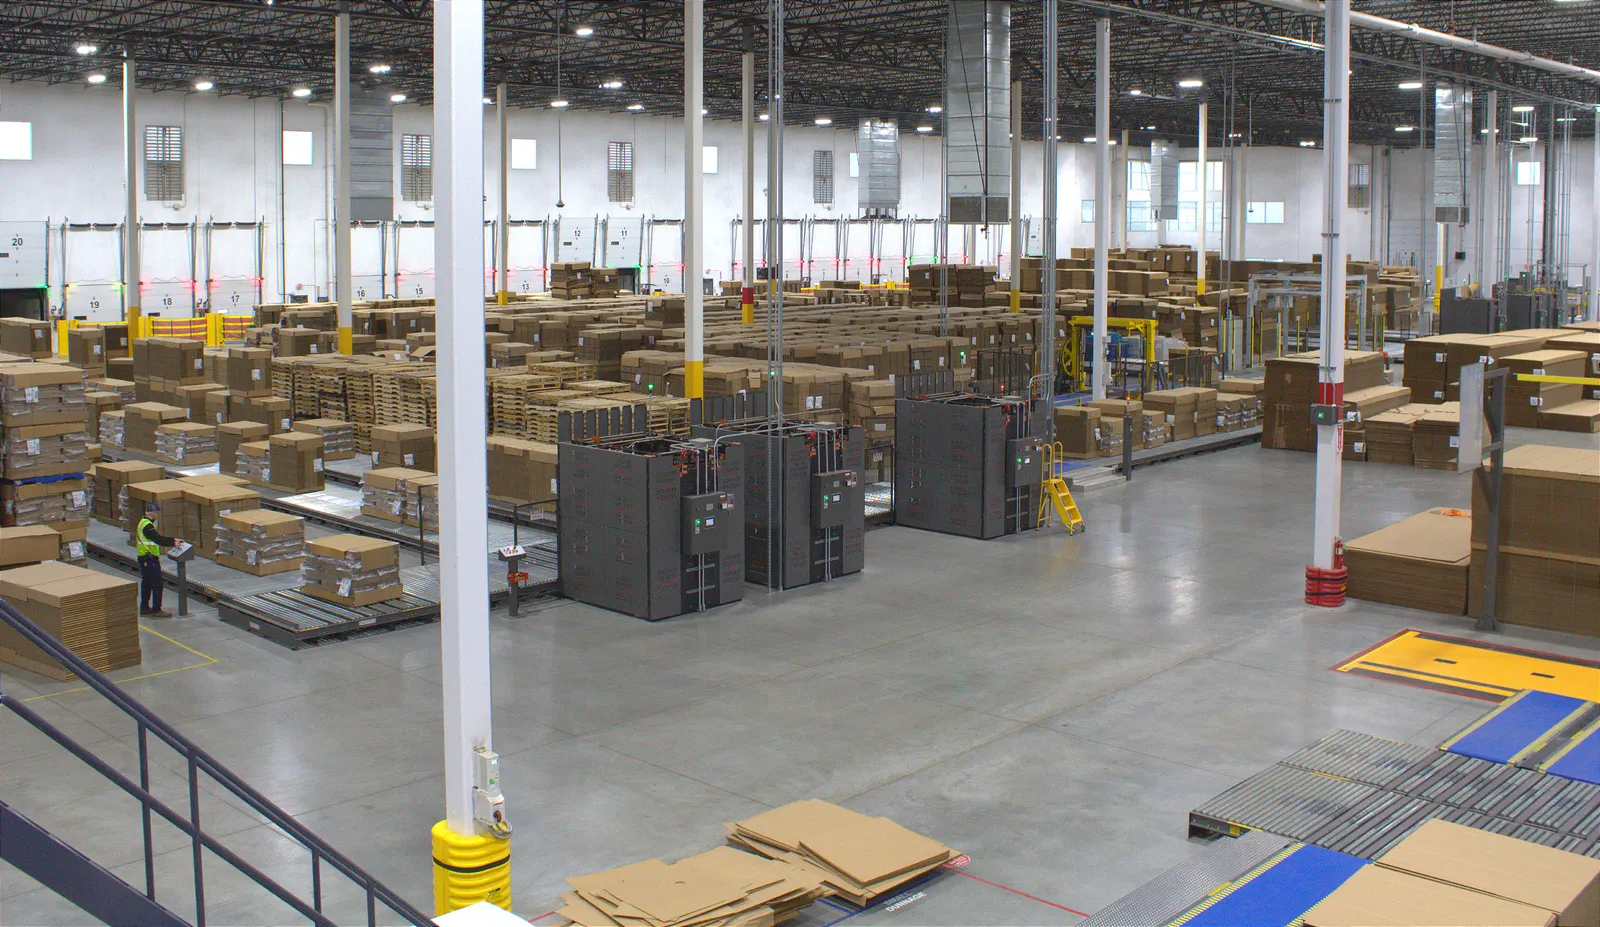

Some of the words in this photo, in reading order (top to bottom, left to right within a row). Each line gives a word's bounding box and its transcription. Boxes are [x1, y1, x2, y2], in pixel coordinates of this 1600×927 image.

[12, 237, 23, 246] 20
[357, 289, 366, 297] 16
[415, 287, 424, 295] 15
[162, 297, 173, 306] 18
[231, 294, 240, 303] 17
[89, 300, 100, 309] 19
[885, 891, 928, 912] DUNNAGE
